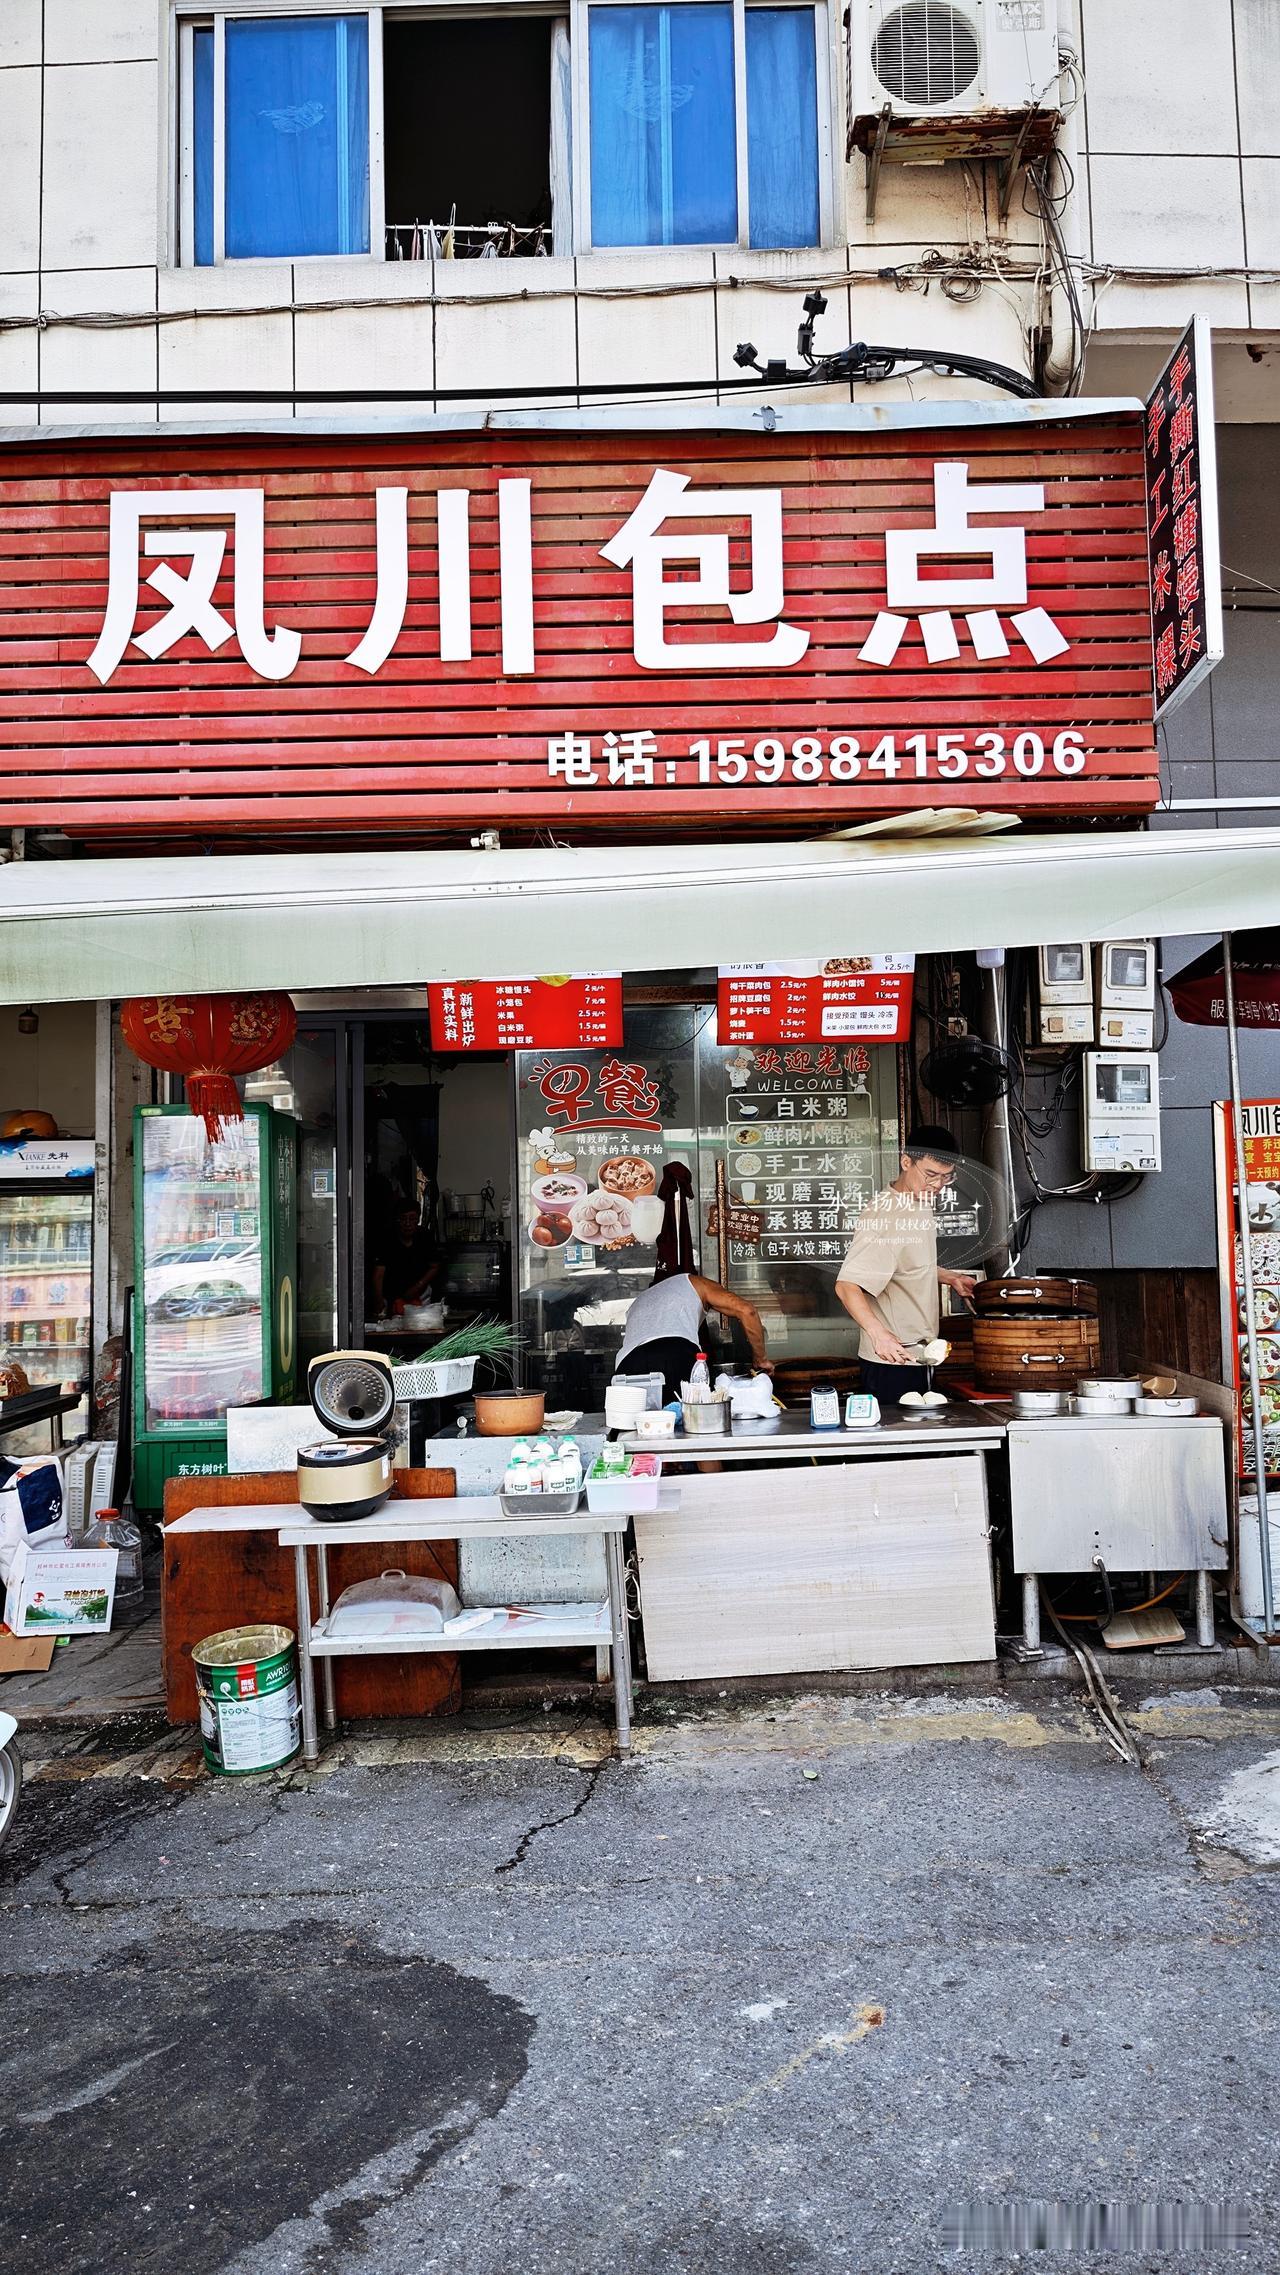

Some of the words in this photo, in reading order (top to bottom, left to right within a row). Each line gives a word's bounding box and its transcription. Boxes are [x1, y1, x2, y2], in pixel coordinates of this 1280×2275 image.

[1147, 387, 1177, 695] 手工米粿
[86, 463, 1071, 686] 凤川包点
[729, 981, 772, 991] 梅干菜肉包
[496, 998, 524, 1007] 小笼包
[822, 991, 857, 1001] 鲜肉水饺
[441, 986, 459, 1042] 真材实料
[459, 992, 476, 1047] 新鲜出炉
[497, 1011, 515, 1020] 米果
[498, 1023, 525, 1033] 白米粥
[498, 1035, 534, 1045] 现磨豆浆
[729, 1031, 754, 1040] 茶叶蛋
[754, 1045, 871, 1076] 欢迎光临
[540, 1058, 660, 1123] 早餐
[757, 1078, 844, 1092] WELCOME
[777, 1097, 848, 1117] 白米粥
[575, 1133, 630, 1144] 精致的一天
[763, 1125, 863, 1146] 鲜肉小馄饨
[576, 1143, 663, 1155] 从美味的早餐开始
[47, 1152, 70, 1160] 先科
[765, 1152, 864, 1174] 手工水饺
[765, 1181, 865, 1202] 现磨豆浆
[730, 1211, 760, 1224] 营业中
[178, 1463, 225, 1476] 东方树叶
